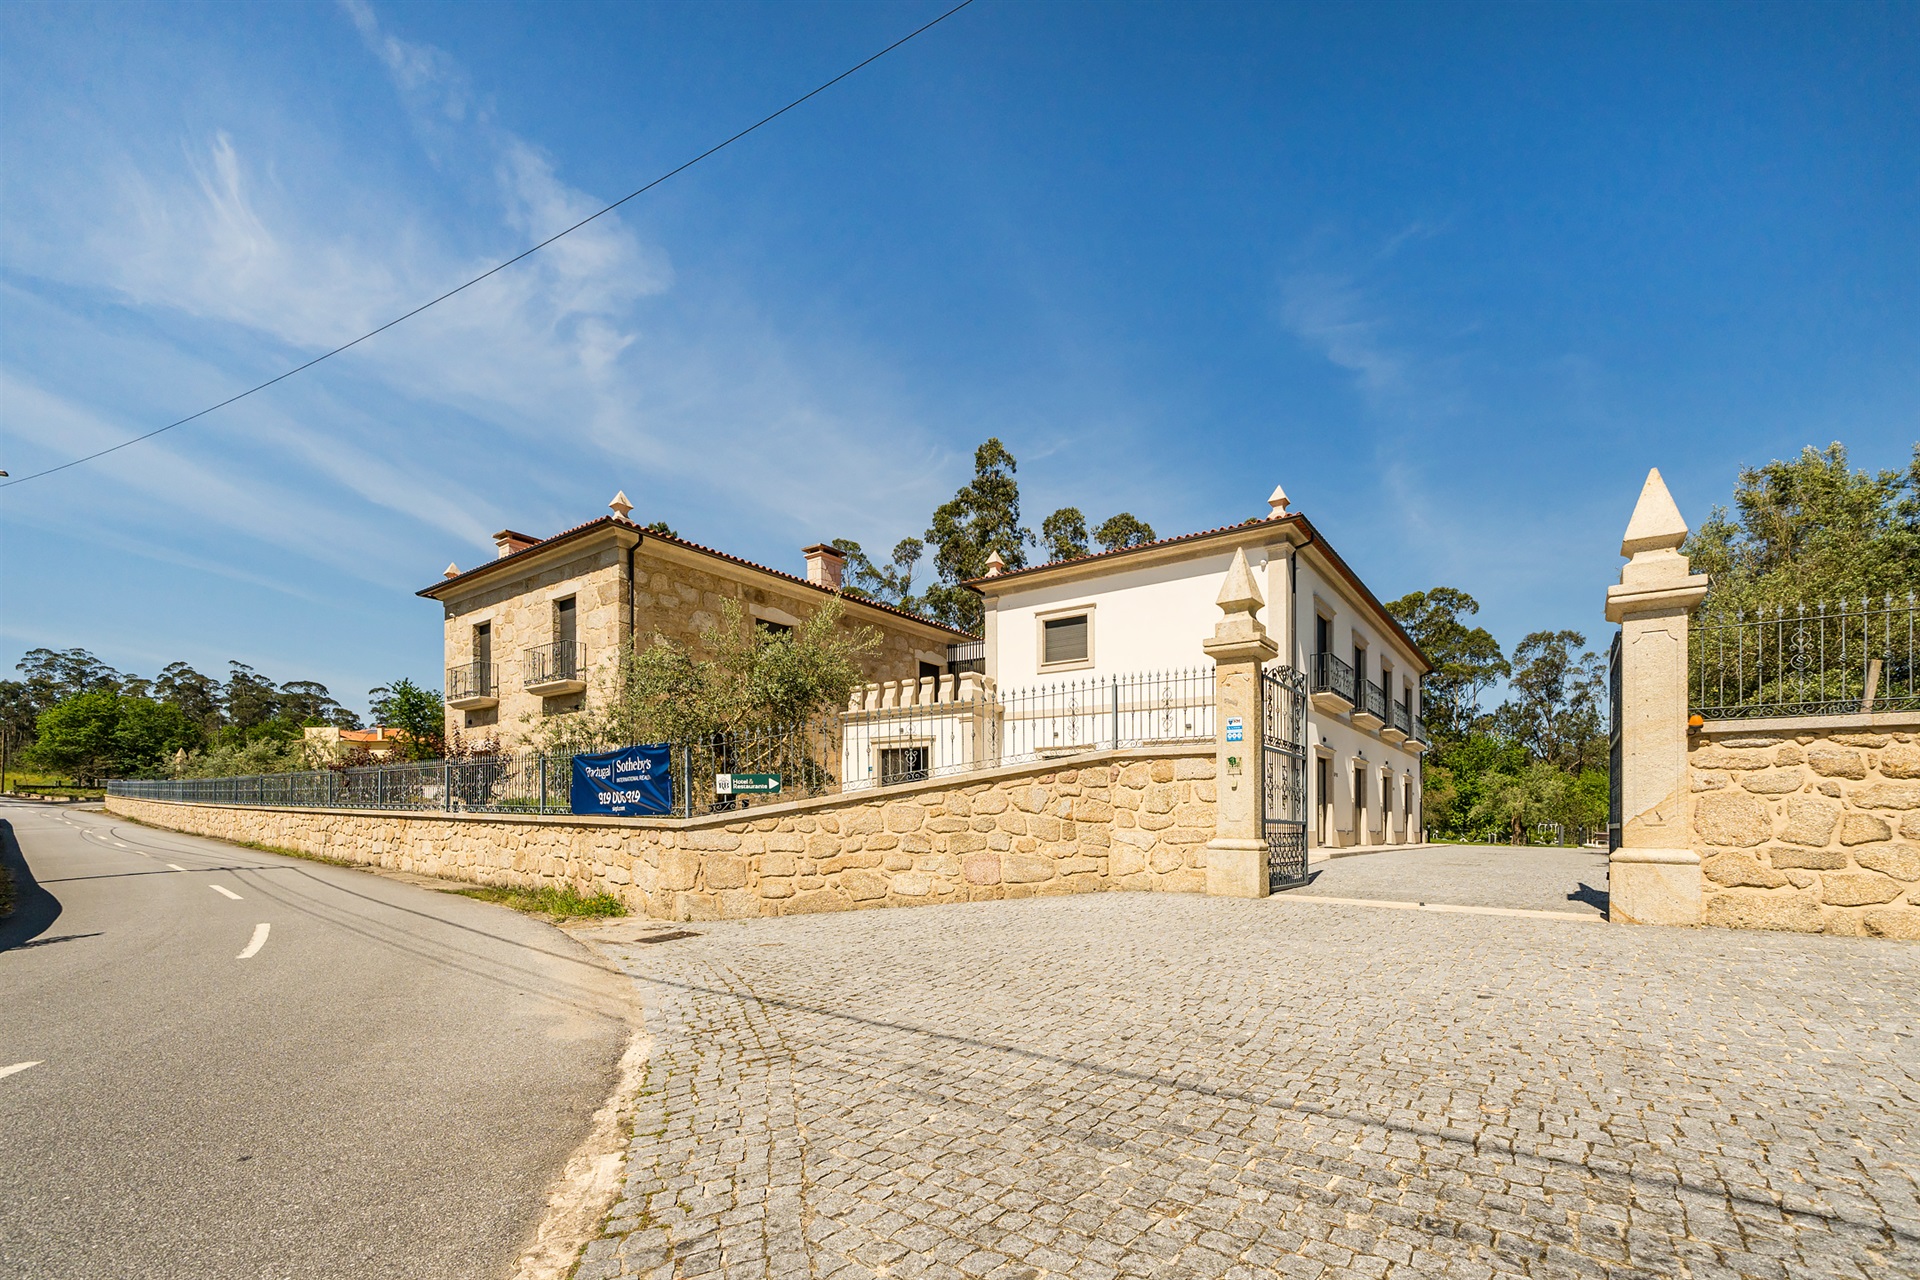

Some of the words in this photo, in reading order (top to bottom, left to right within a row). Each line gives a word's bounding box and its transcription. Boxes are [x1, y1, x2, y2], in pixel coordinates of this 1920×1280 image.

[585, 765, 611, 779] Portugal
[616, 756, 652, 773] Sotheby's
[598, 792, 612, 805] 919
[626, 790, 641, 803] 919
